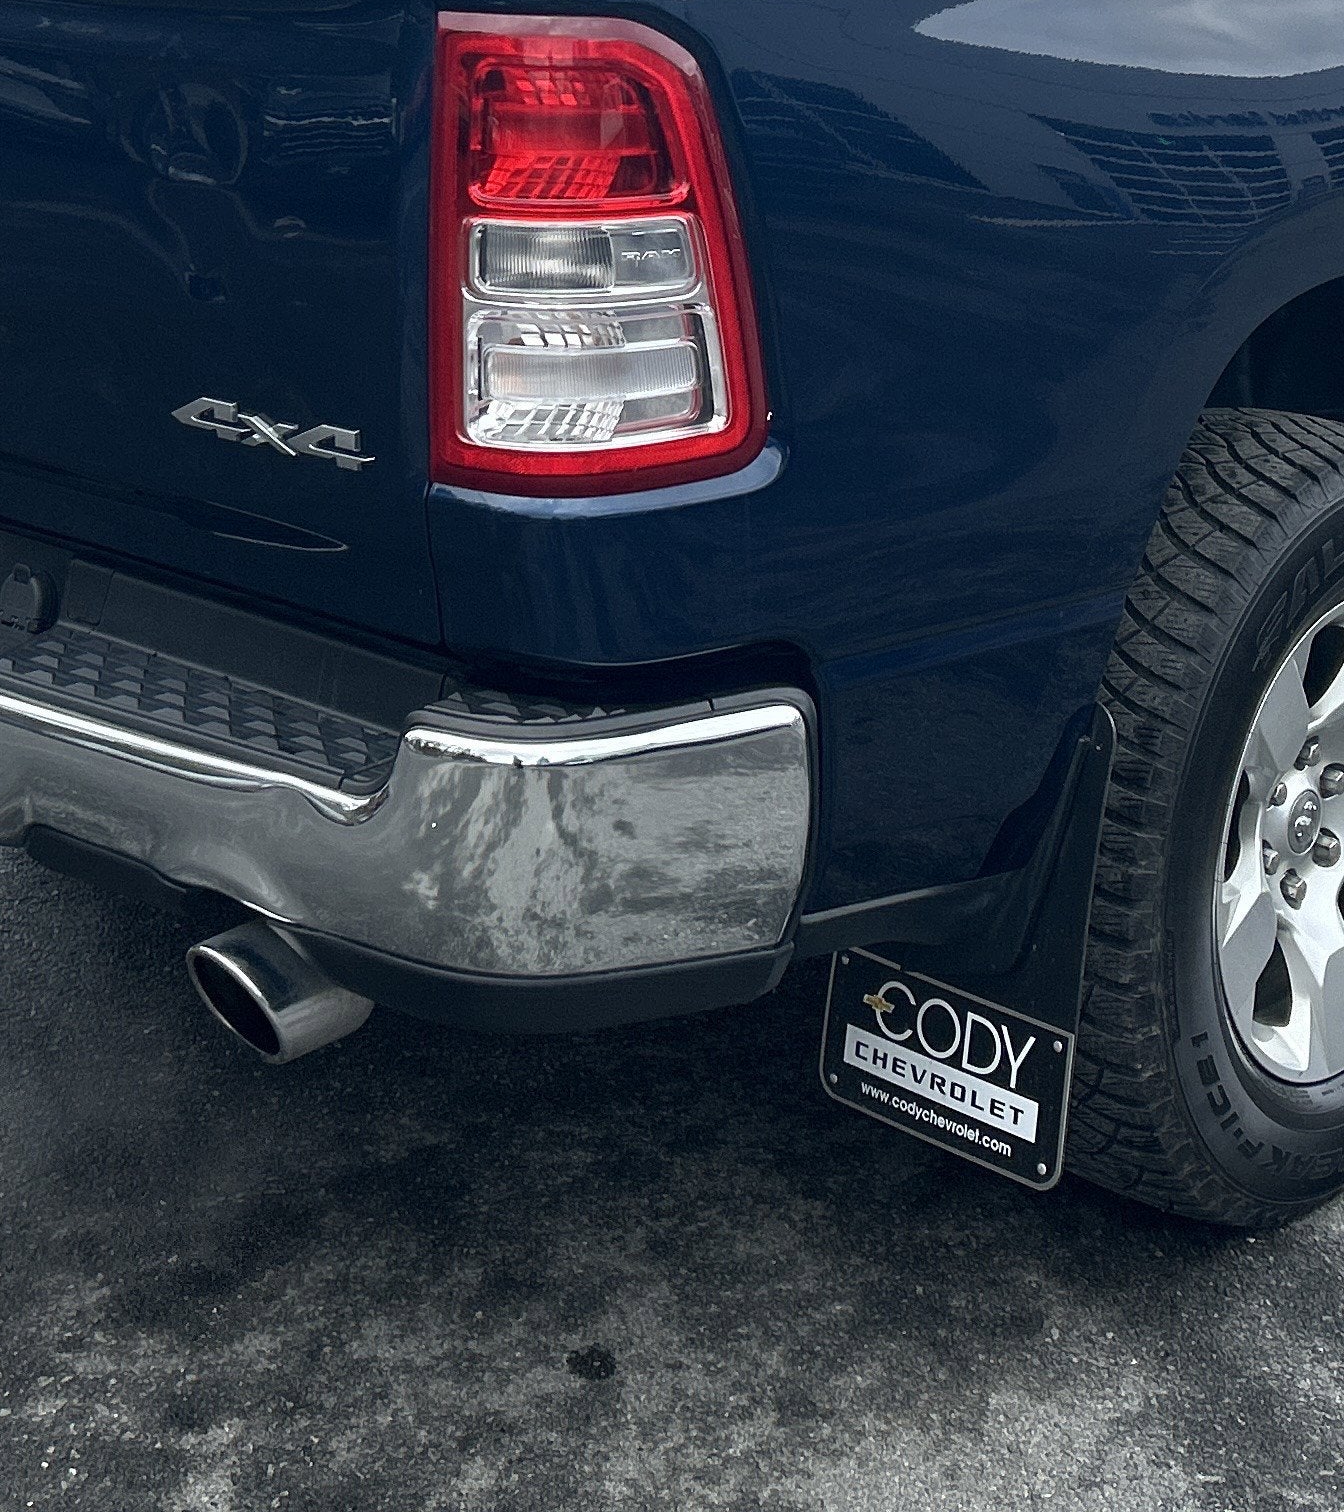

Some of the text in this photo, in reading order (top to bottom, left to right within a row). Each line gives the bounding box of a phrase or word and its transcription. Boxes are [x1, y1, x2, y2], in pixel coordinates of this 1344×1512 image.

[621, 248, 681, 268] RAM
[875, 980, 1036, 1089] CODY
[855, 1040, 1025, 1126] CHEVROLET
[861, 1081, 1012, 1157] www.codychevrolet.com
